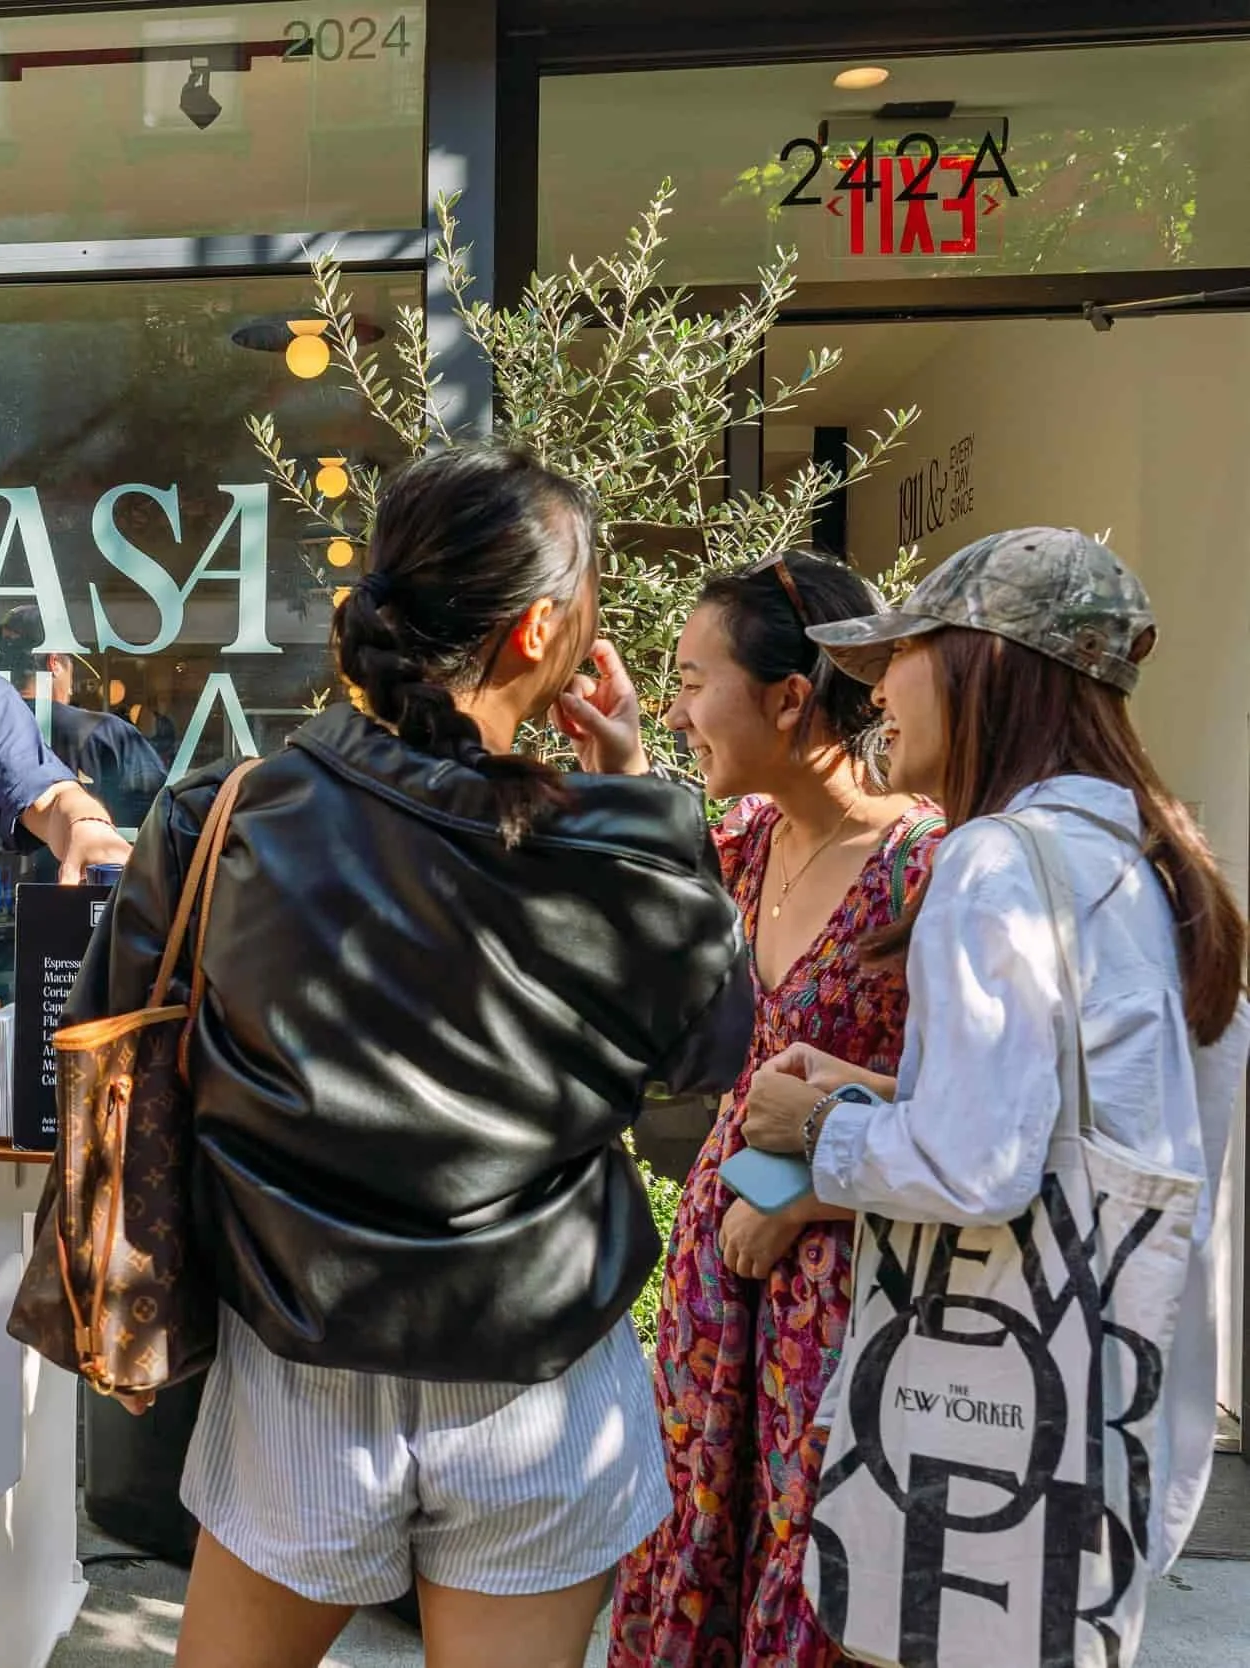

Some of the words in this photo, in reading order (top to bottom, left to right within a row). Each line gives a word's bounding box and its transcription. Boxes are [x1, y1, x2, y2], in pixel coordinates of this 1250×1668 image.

[282, 15, 411, 63] 2024
[779, 130, 1018, 206] 242A
[899, 467, 923, 546] 1911
[927, 459, 947, 533] &
[44, 971, 77, 983] Macchi
[43, 986, 71, 998] Corta
[43, 1015, 58, 1026] Fla
[42, 1074, 57, 1086] Col
[949, 1383, 969, 1396] THE
[894, 1386, 941, 1414] NEW
[942, 1394, 1025, 1430] YORKER
